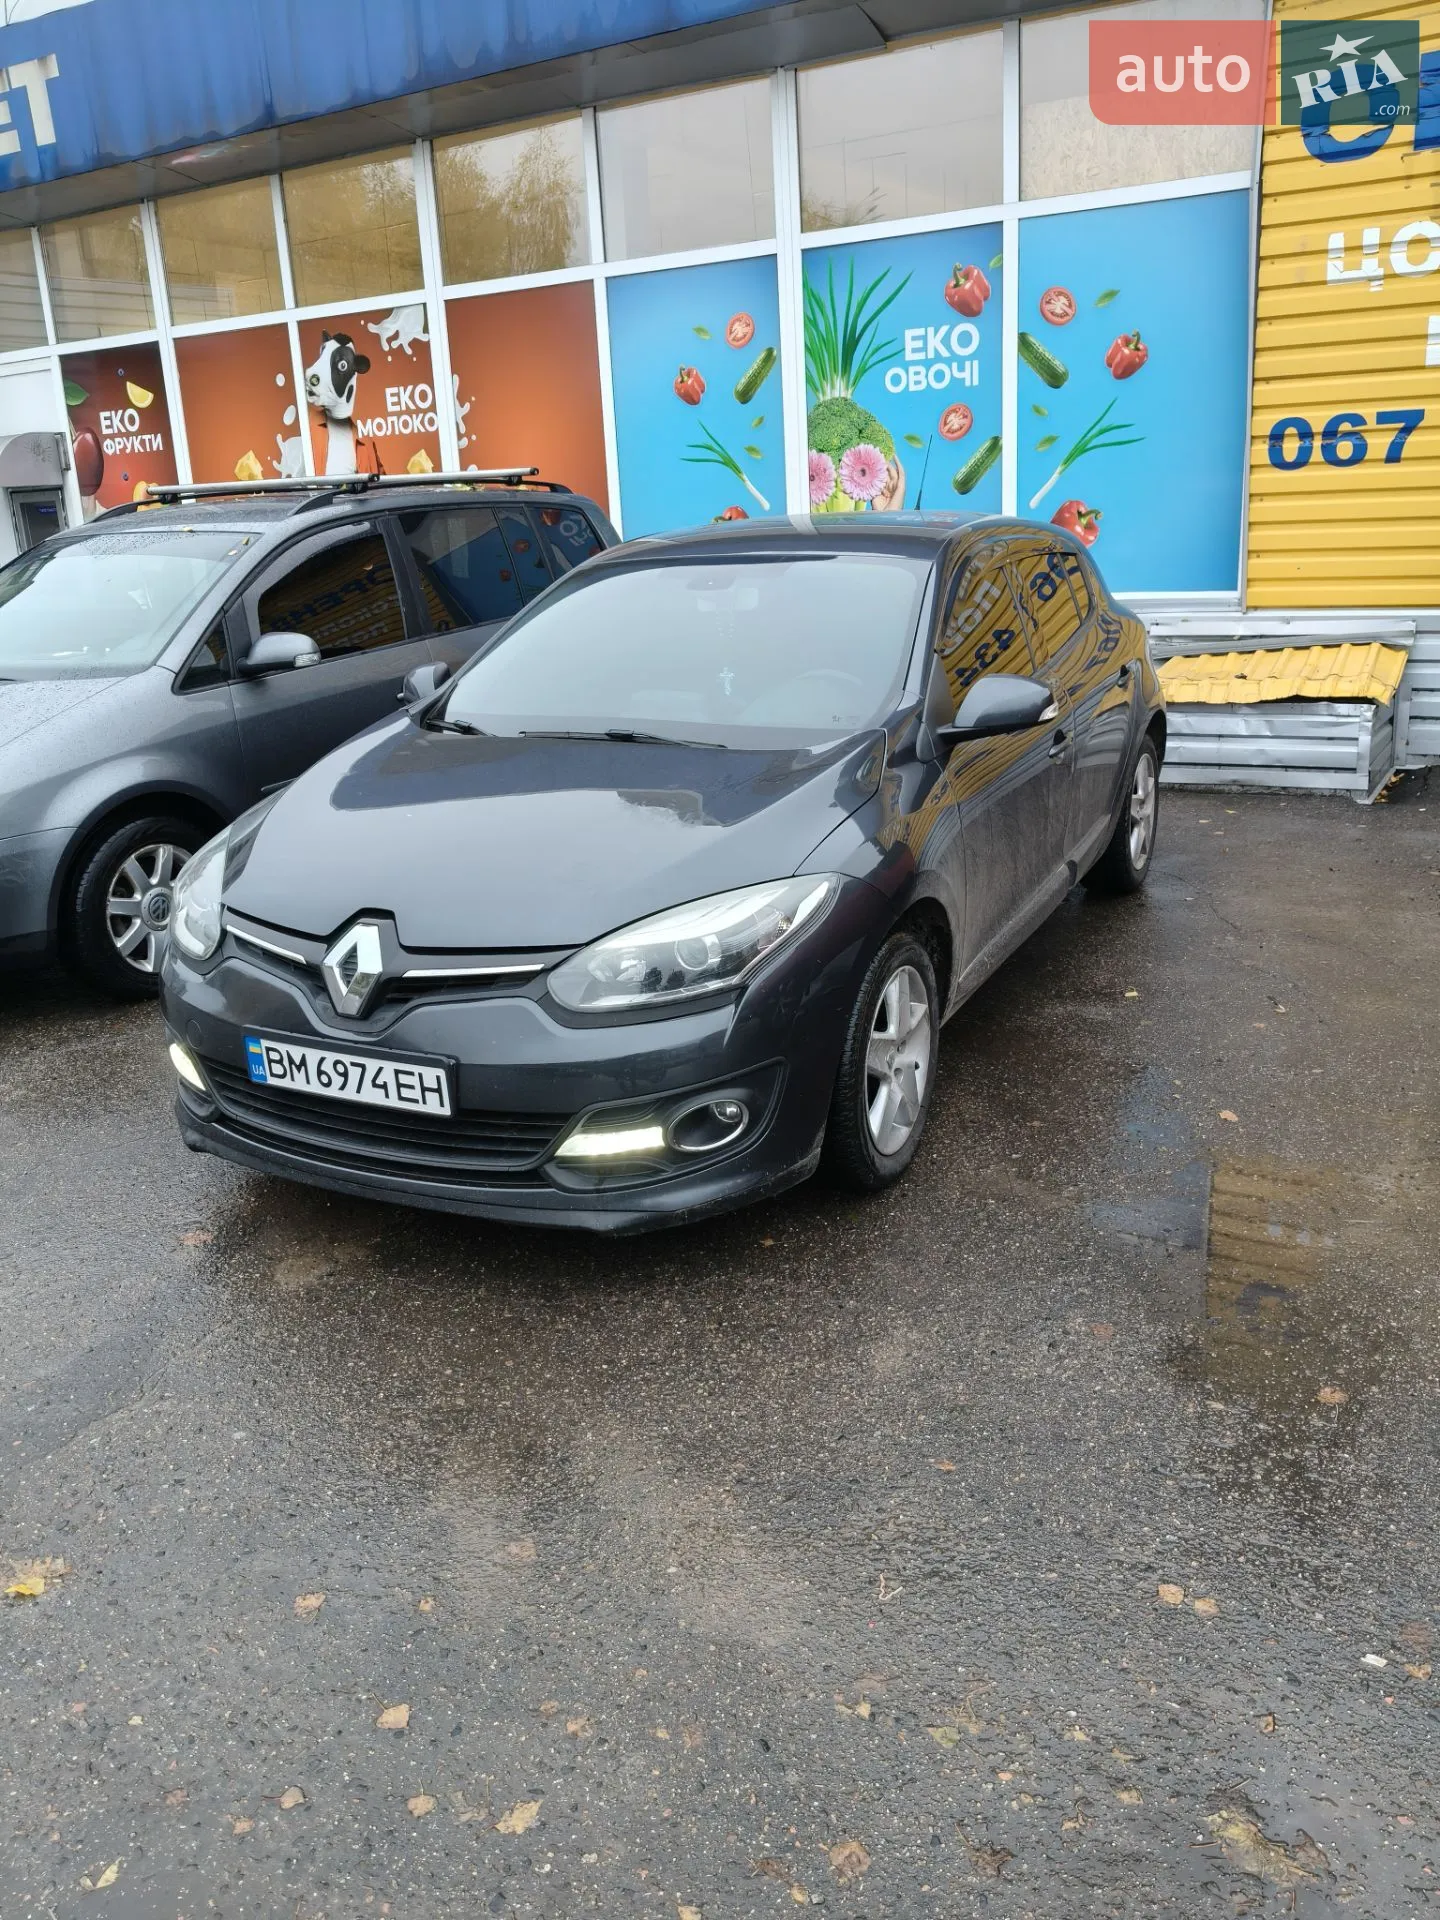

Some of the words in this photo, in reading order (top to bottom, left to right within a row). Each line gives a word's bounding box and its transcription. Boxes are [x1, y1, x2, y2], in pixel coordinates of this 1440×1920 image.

[904, 322, 980, 362] ЕКО
[884, 360, 979, 394] ОВОЧІ
[385, 383, 433, 412] ЕКО
[99, 408, 140, 435] ЕКО
[356, 411, 439, 438] МОЛОКО
[103, 433, 164, 456] ФРУКТИ
[1267, 408, 1425, 470] 067
[252, 1064, 266, 1076] UA
